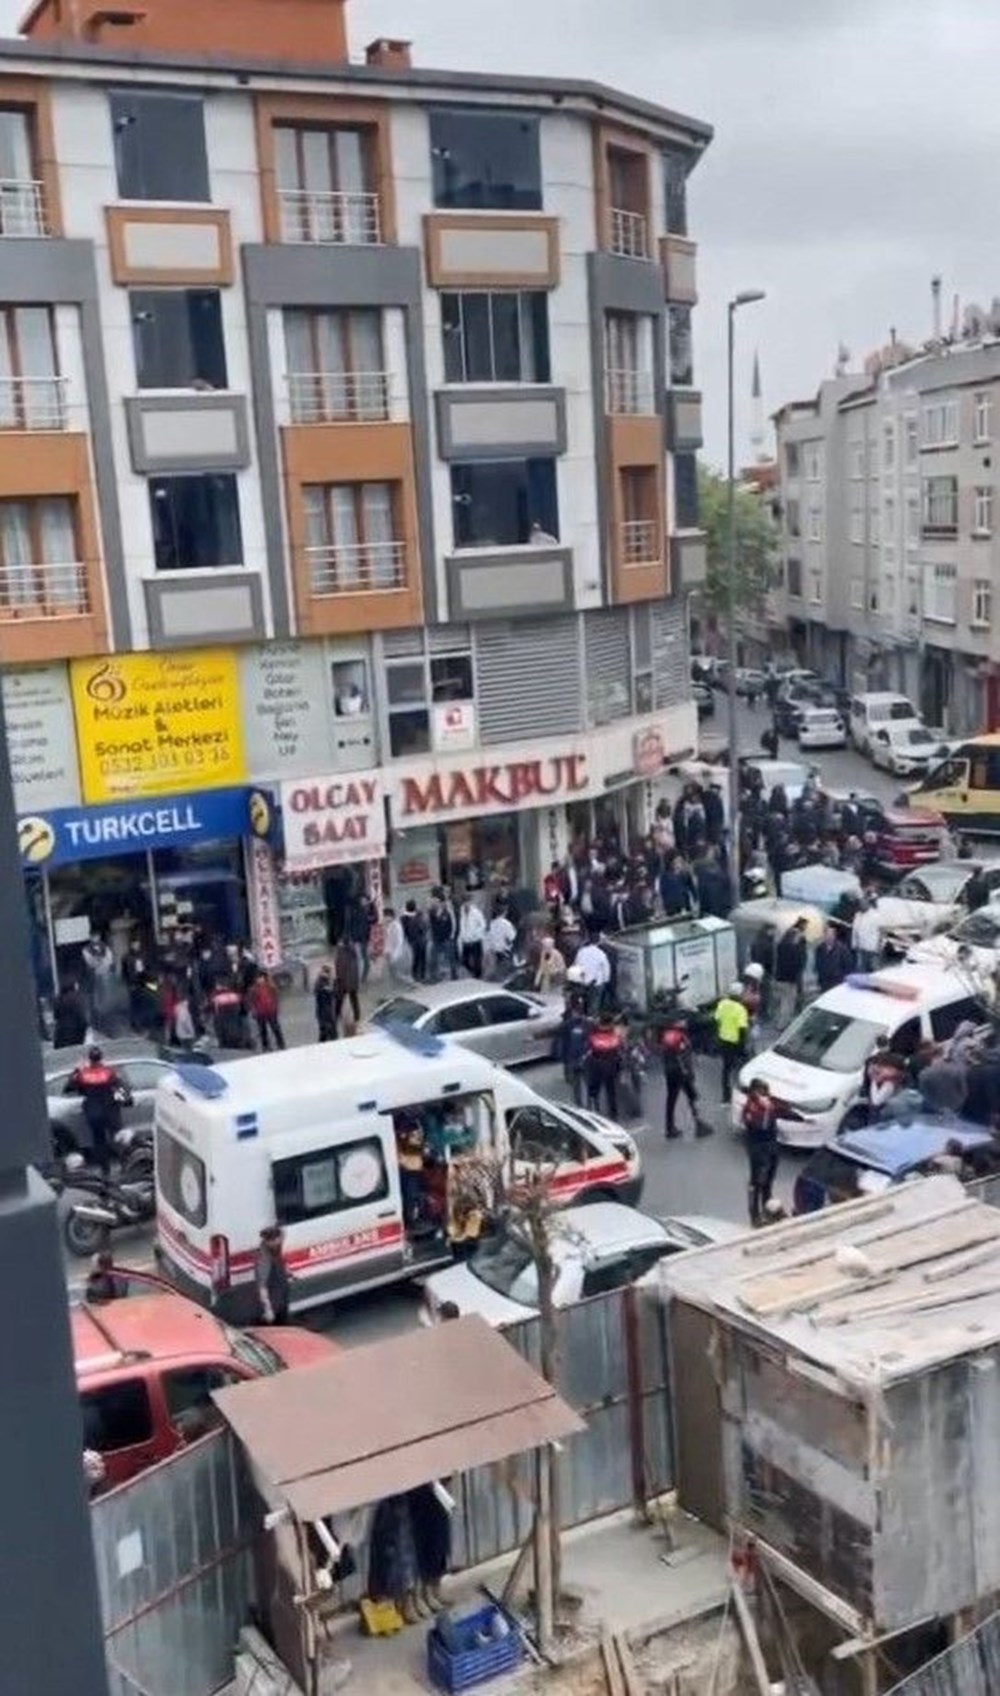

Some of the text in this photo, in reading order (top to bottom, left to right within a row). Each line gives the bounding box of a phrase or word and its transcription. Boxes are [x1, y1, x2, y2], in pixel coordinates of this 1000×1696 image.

[93, 703, 150, 721] Müzik
[155, 717, 168, 733] &
[94, 730, 229, 757] Sanat Merkezi
[290, 779, 377, 813] OLCAY
[402, 753, 589, 815] MAKBUL
[64, 805, 202, 847] TURKCELL
[303, 815, 369, 846] SAAT
